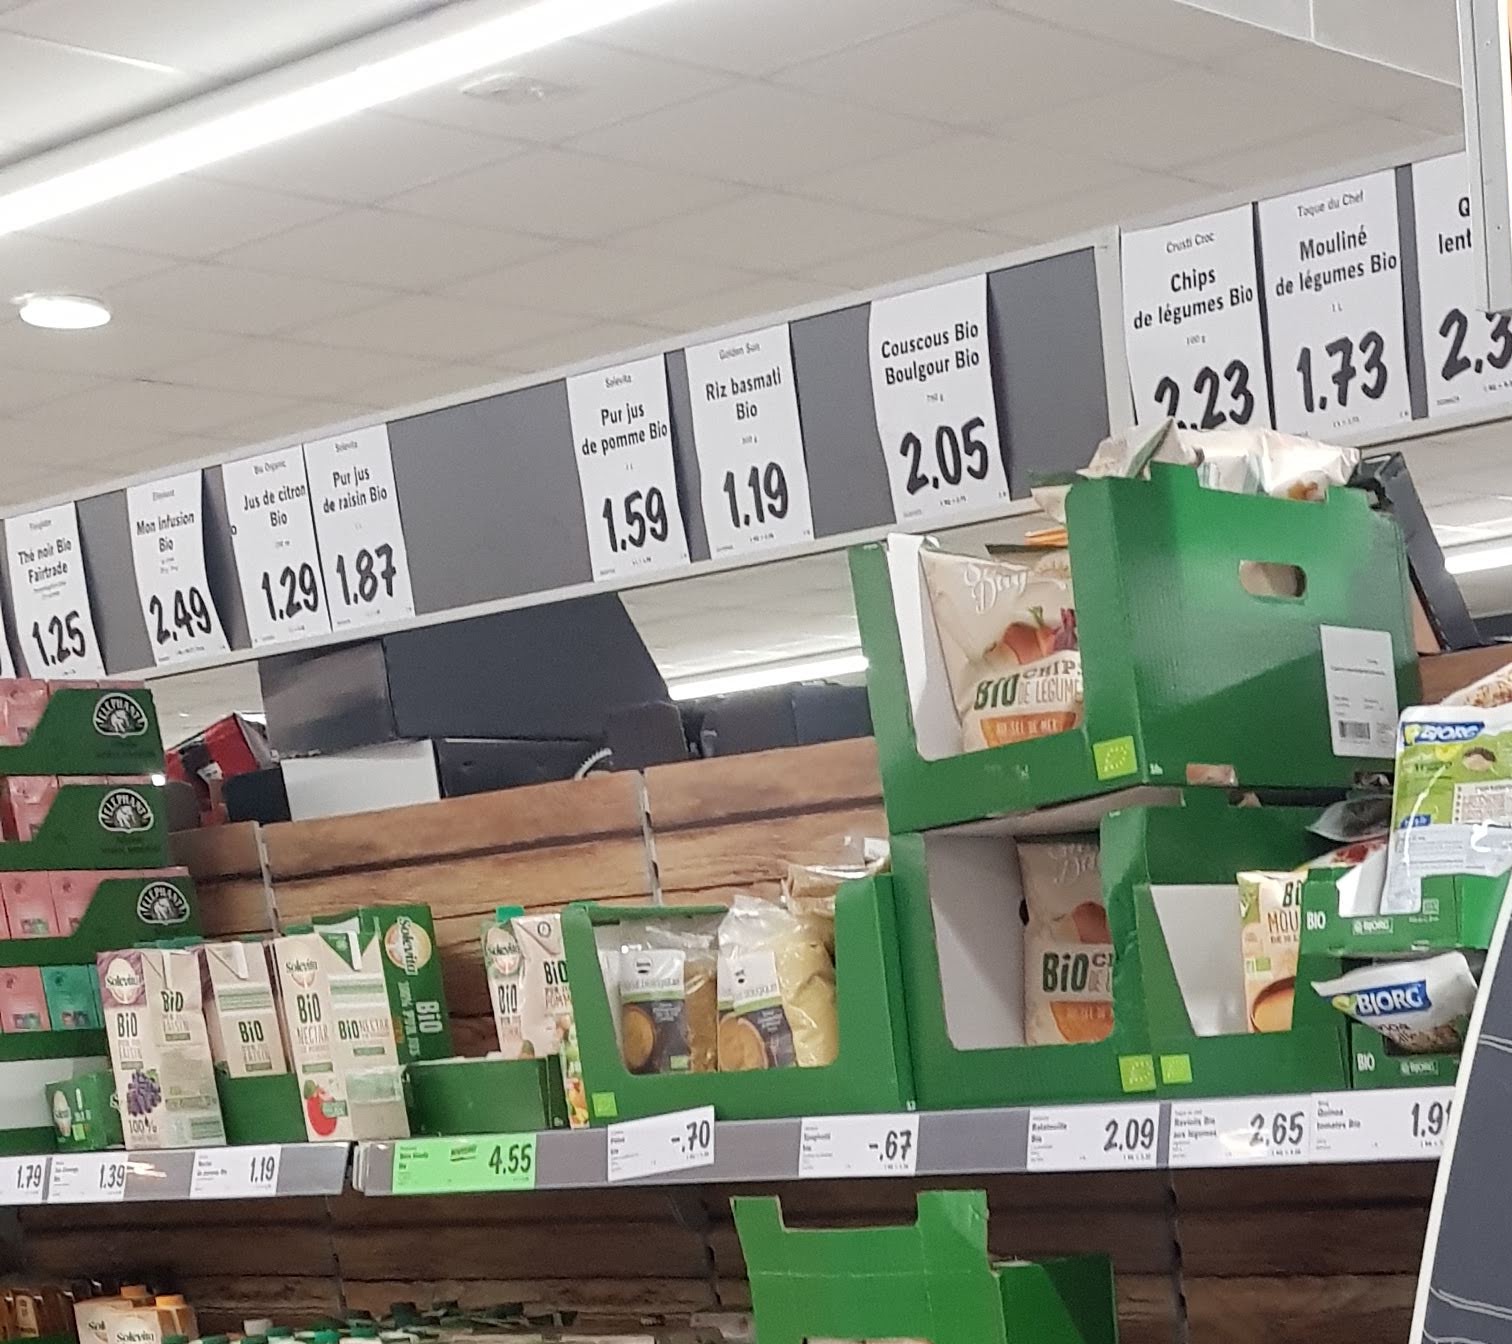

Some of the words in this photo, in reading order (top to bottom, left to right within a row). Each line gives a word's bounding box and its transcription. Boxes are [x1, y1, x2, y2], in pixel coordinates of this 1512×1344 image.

[1296, 200, 1326, 218] Toque
[1328, 197, 1340, 210] du
[1341, 188, 1366, 208] Chef
[1193, 230, 1216, 249] Croc
[1298, 224, 1368, 262] Mouliné
[1169, 266, 1217, 294] Chips
[1275, 276, 1295, 298] de
[1297, 259, 1367, 293] légumes
[1369, 252, 1398, 273] Bio
[1133, 310, 1154, 331] de
[1156, 292, 1226, 327] légumes
[1228, 285, 1255, 306] Bio
[881, 329, 951, 359] Couscous
[953, 321, 980, 344] Bio
[884, 357, 951, 387] Boulgour
[954, 349, 980, 370] Bio
[1296, 331, 1388, 413] 1.73
[705, 382, 727, 402] Riz
[730, 366, 783, 397] basmati
[1153, 359, 1256, 431] 2.23
[600, 405, 624, 427] Pur
[625, 402, 646, 423] jus
[735, 402, 758, 421] Bio
[581, 436, 599, 457] de
[600, 429, 647, 456] pomme
[648, 418, 669, 440] Bio
[899, 416, 990, 498] 2.05
[332, 469, 351, 488] Pur
[352, 465, 372, 485] jus
[242, 492, 262, 511] Jus
[262, 488, 277, 505] de
[277, 482, 307, 503] citron
[322, 496, 337, 514] de
[338, 491, 368, 511] raisin
[369, 486, 389, 504] Bio
[722, 461, 789, 530] 1.19
[135, 518, 157, 537] Mon
[157, 510, 196, 533] Infusion
[269, 510, 289, 528] Bio
[601, 485, 669, 553] 1.59
[17, 550, 37, 566] Thé
[37, 543, 56, 562] noir
[55, 538, 73, 556] Bio
[158, 536, 175, 554] Bio
[27, 561, 70, 585] Fairtrade
[336, 543, 398, 608] 1.87
[260, 562, 320, 623] 1.29
[148, 586, 213, 648] 2.49
[31, 609, 87, 668] 1.25
[95, 698, 143, 728] ELEPHANT
[103, 794, 149, 824] ELEPHANT
[140, 887, 187, 917] ELEPHANT
[1306, 910, 1327, 931] BIO
[1356, 987, 1426, 1017] BJORG
[1357, 1052, 1376, 1072] BIO
[1103, 1116, 1156, 1152] 2.09
[1249, 1111, 1306, 1148] 2.65
[249, 1156, 276, 1184] 1.19
[488, 1143, 533, 1176] 4.55
[16, 1163, 43, 1190] 1.79
[99, 1163, 126, 1189] 1.39
